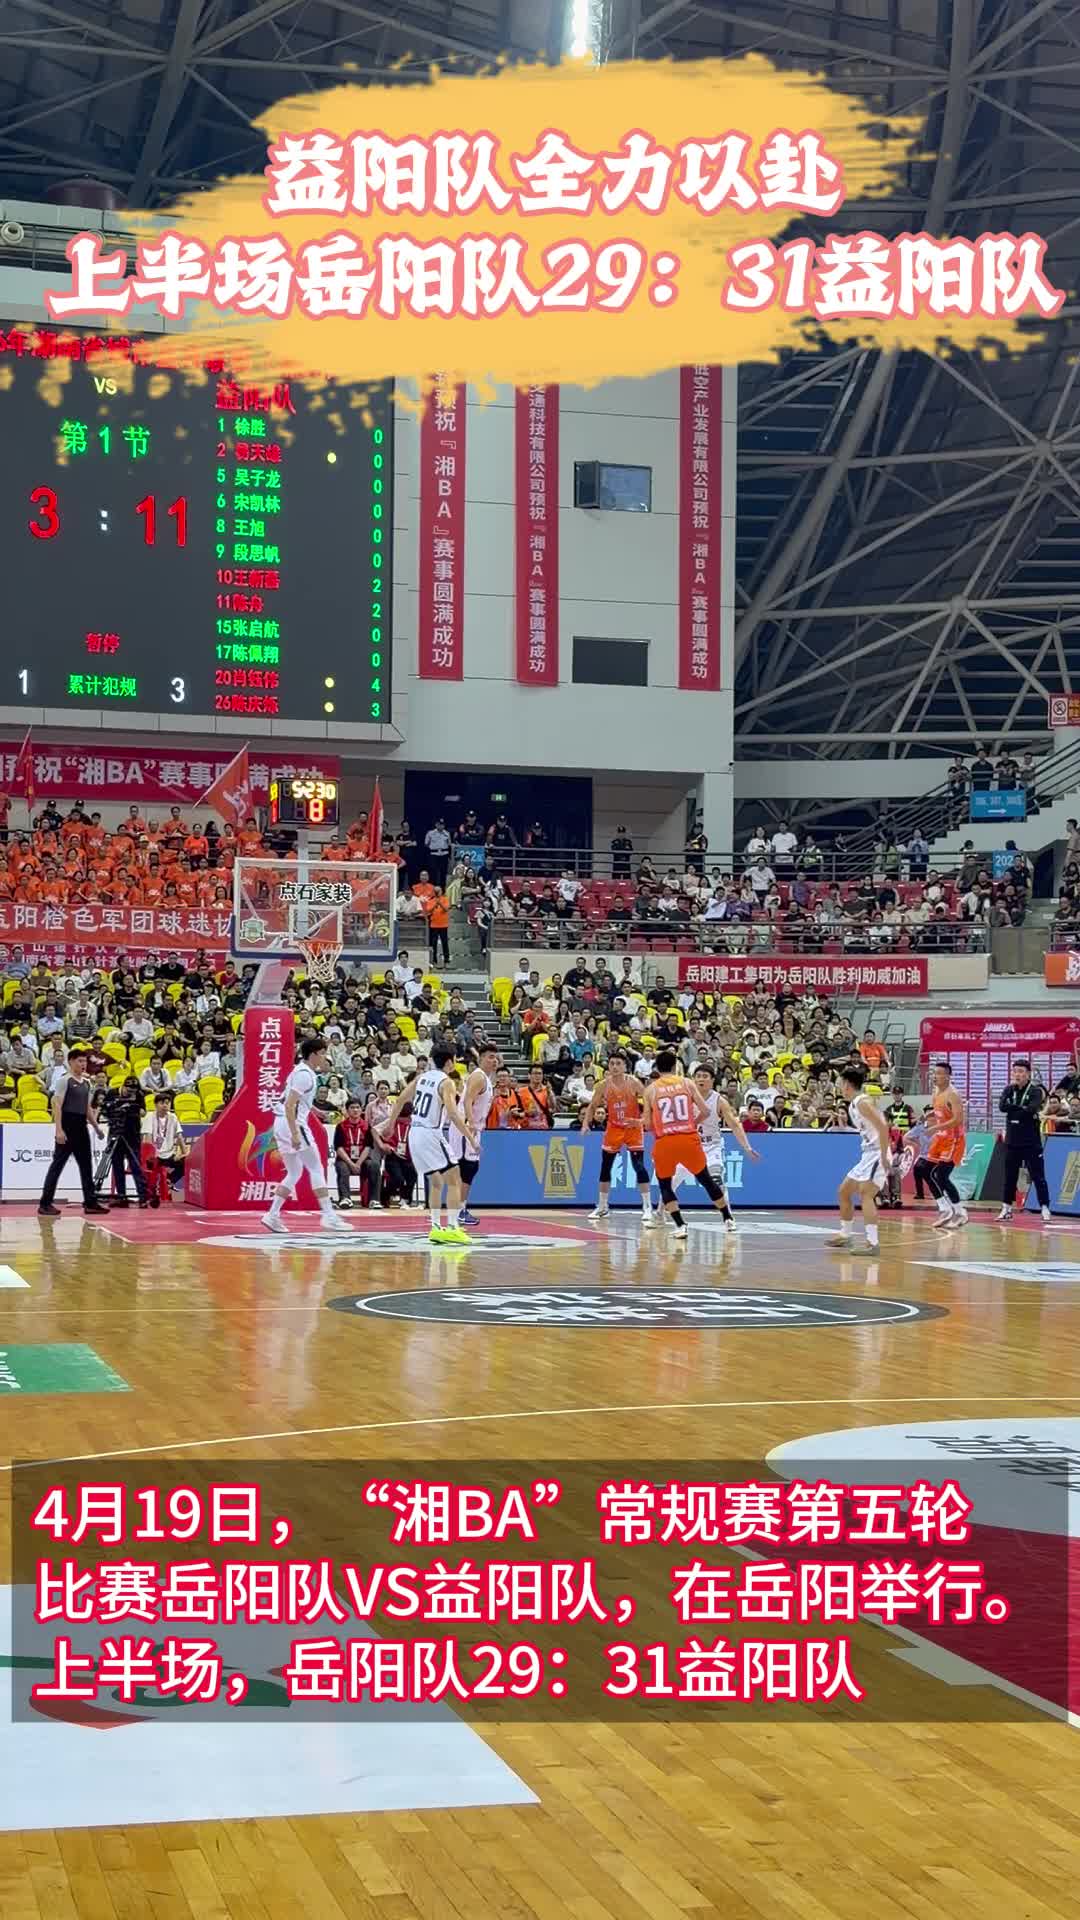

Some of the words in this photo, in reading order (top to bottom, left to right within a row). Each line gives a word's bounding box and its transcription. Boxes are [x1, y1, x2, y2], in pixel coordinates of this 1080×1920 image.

[93, 377, 118, 395] VS
[219, 418, 225, 432] 1
[374, 429, 383, 445] 0
[217, 442, 226, 457] 2
[374, 454, 383, 470] 0
[217, 468, 226, 482] 5
[235, 468, 282, 489] 吴子龙
[374, 479, 383, 495] 0
[29, 485, 60, 539] 3
[134, 495, 187, 547] 11
[217, 493, 226, 508] 6
[235, 493, 281, 513] 宋凯林
[373, 504, 382, 520] 0
[216, 519, 226, 533] 8
[234, 518, 265, 538] 王旭
[373, 529, 382, 544] 0
[216, 544, 226, 559] 9
[373, 553, 382, 569] 0
[373, 579, 381, 593] 2
[373, 603, 381, 619] 2
[85, 632, 121, 655] 暂停
[372, 628, 380, 643] 0
[372, 653, 380, 668] 0
[18, 669, 29, 695] 1
[67, 674, 137, 698] 累计犯规
[170, 677, 185, 703] 3
[372, 678, 381, 693] 4
[372, 703, 380, 718] 3
[309, 798, 324, 822] 8
[279, 881, 352, 902] 点石家装
[685, 964, 921, 985] 岳阳建工集团为岳阳队胜利助威加油
[257, 1016, 283, 1113] 点石家装
[657, 1095, 689, 1124] 20
[10, 1149, 32, 1163] JC
